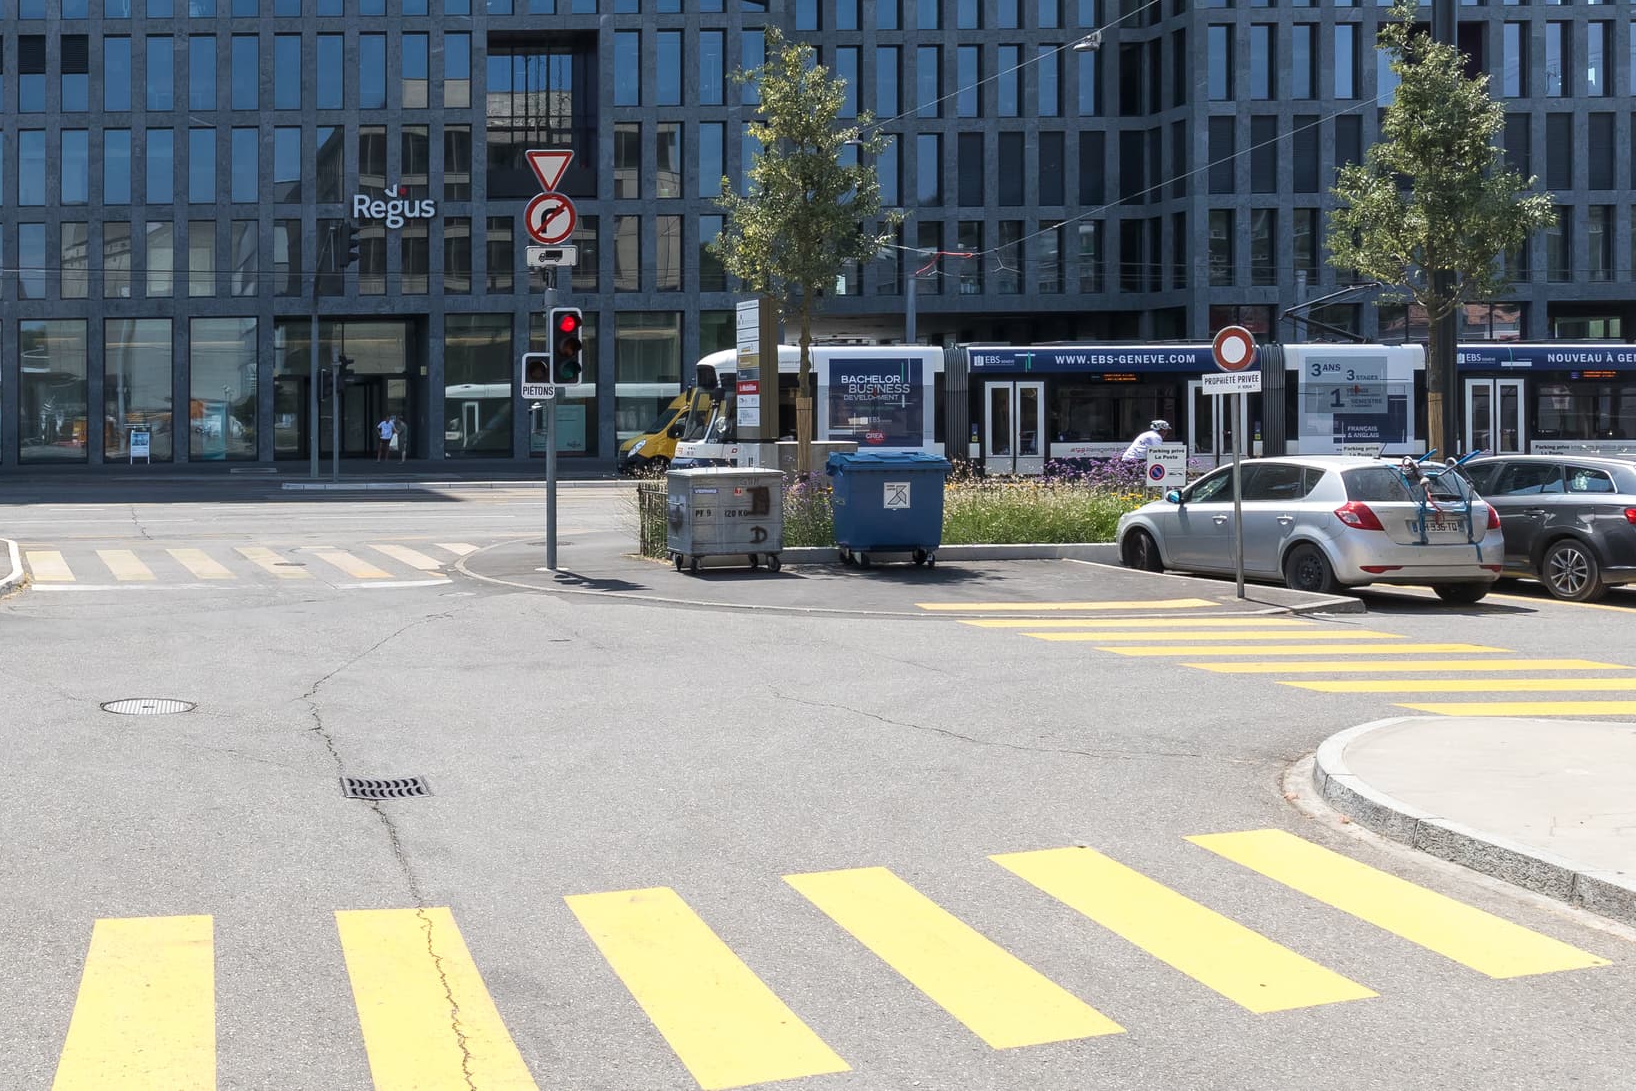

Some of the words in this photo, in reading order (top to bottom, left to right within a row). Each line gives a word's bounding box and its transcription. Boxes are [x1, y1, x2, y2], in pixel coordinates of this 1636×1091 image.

[353, 194, 436, 229] Regus
[985, 356, 1000, 364] EBS
[1055, 354, 1196, 364] WWW.EBS-GENEVE.COM
[1547, 354, 1601, 363] NOUVEAU
[1606, 352, 1614, 363] À
[1311, 363, 1322, 377] 3
[1346, 369, 1355, 381] 3
[841, 375, 901, 384] BACHELOR
[1205, 375, 1236, 385] PROPRIÉTÉ
[1238, 374, 1259, 383] PRIVÉE
[523, 385, 554, 395] PIÉTONS
[1330, 389, 1345, 407] 1
